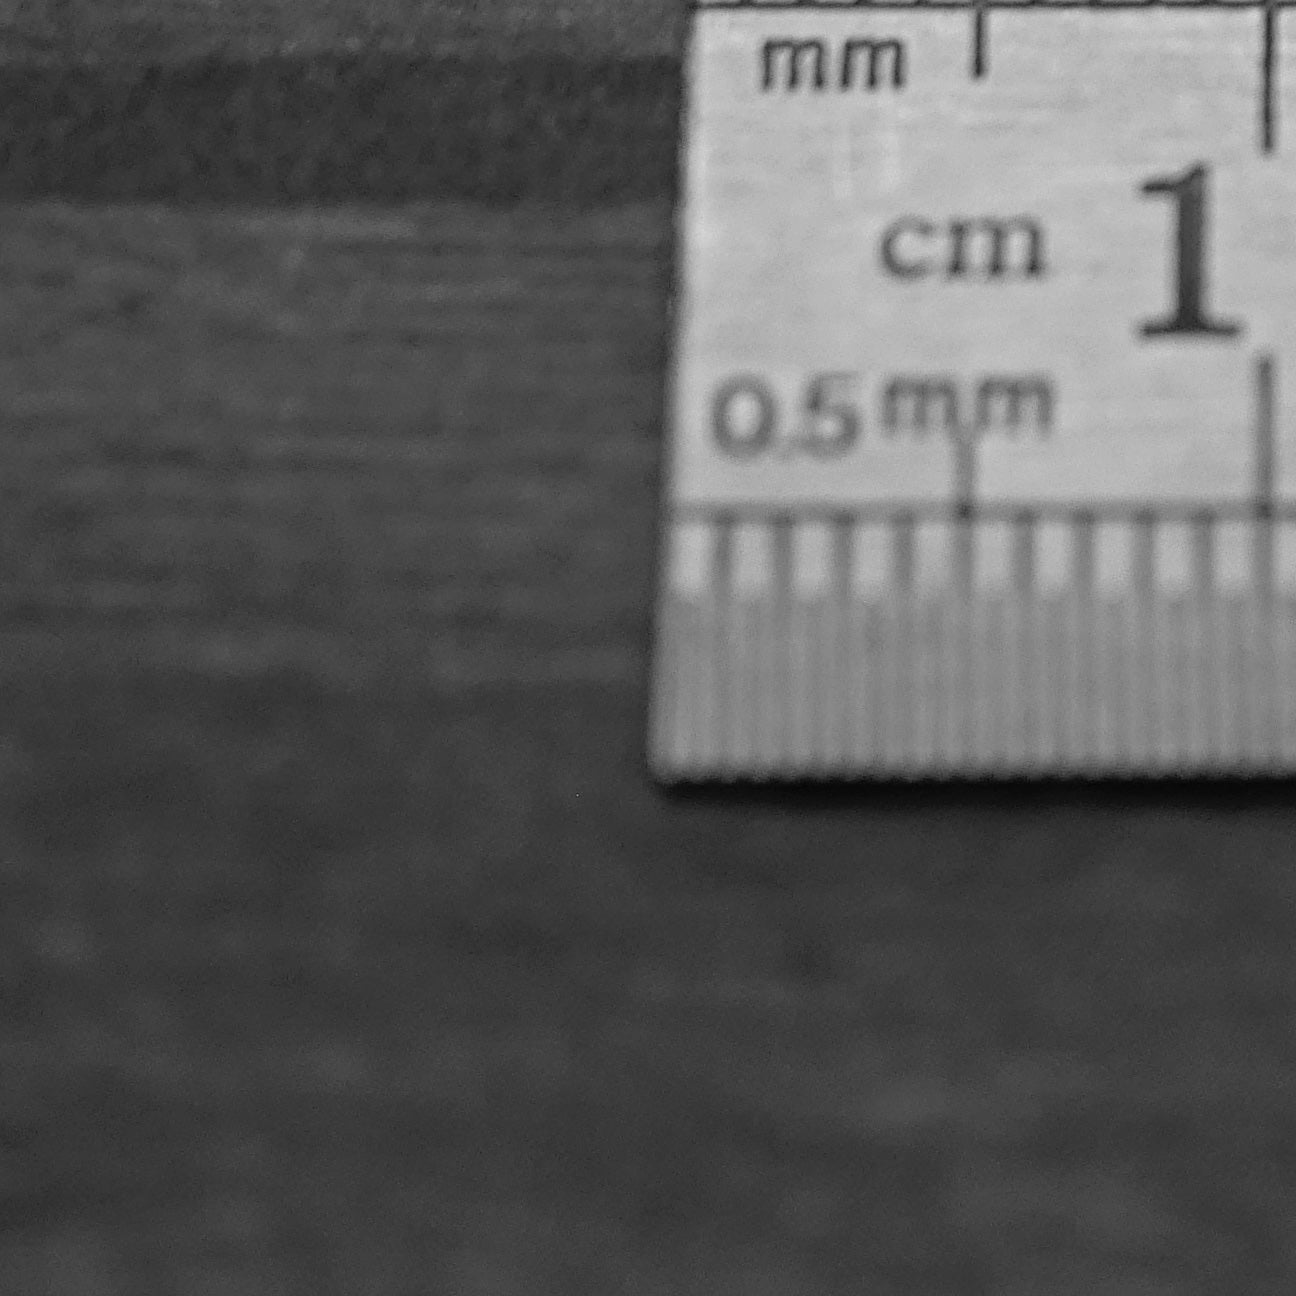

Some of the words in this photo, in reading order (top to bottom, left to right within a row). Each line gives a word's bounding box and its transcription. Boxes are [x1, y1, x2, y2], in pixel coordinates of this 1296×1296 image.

[760, 37, 906, 91] mm
[879, 218, 1046, 282] cm
[1136, 162, 1241, 338] 1
